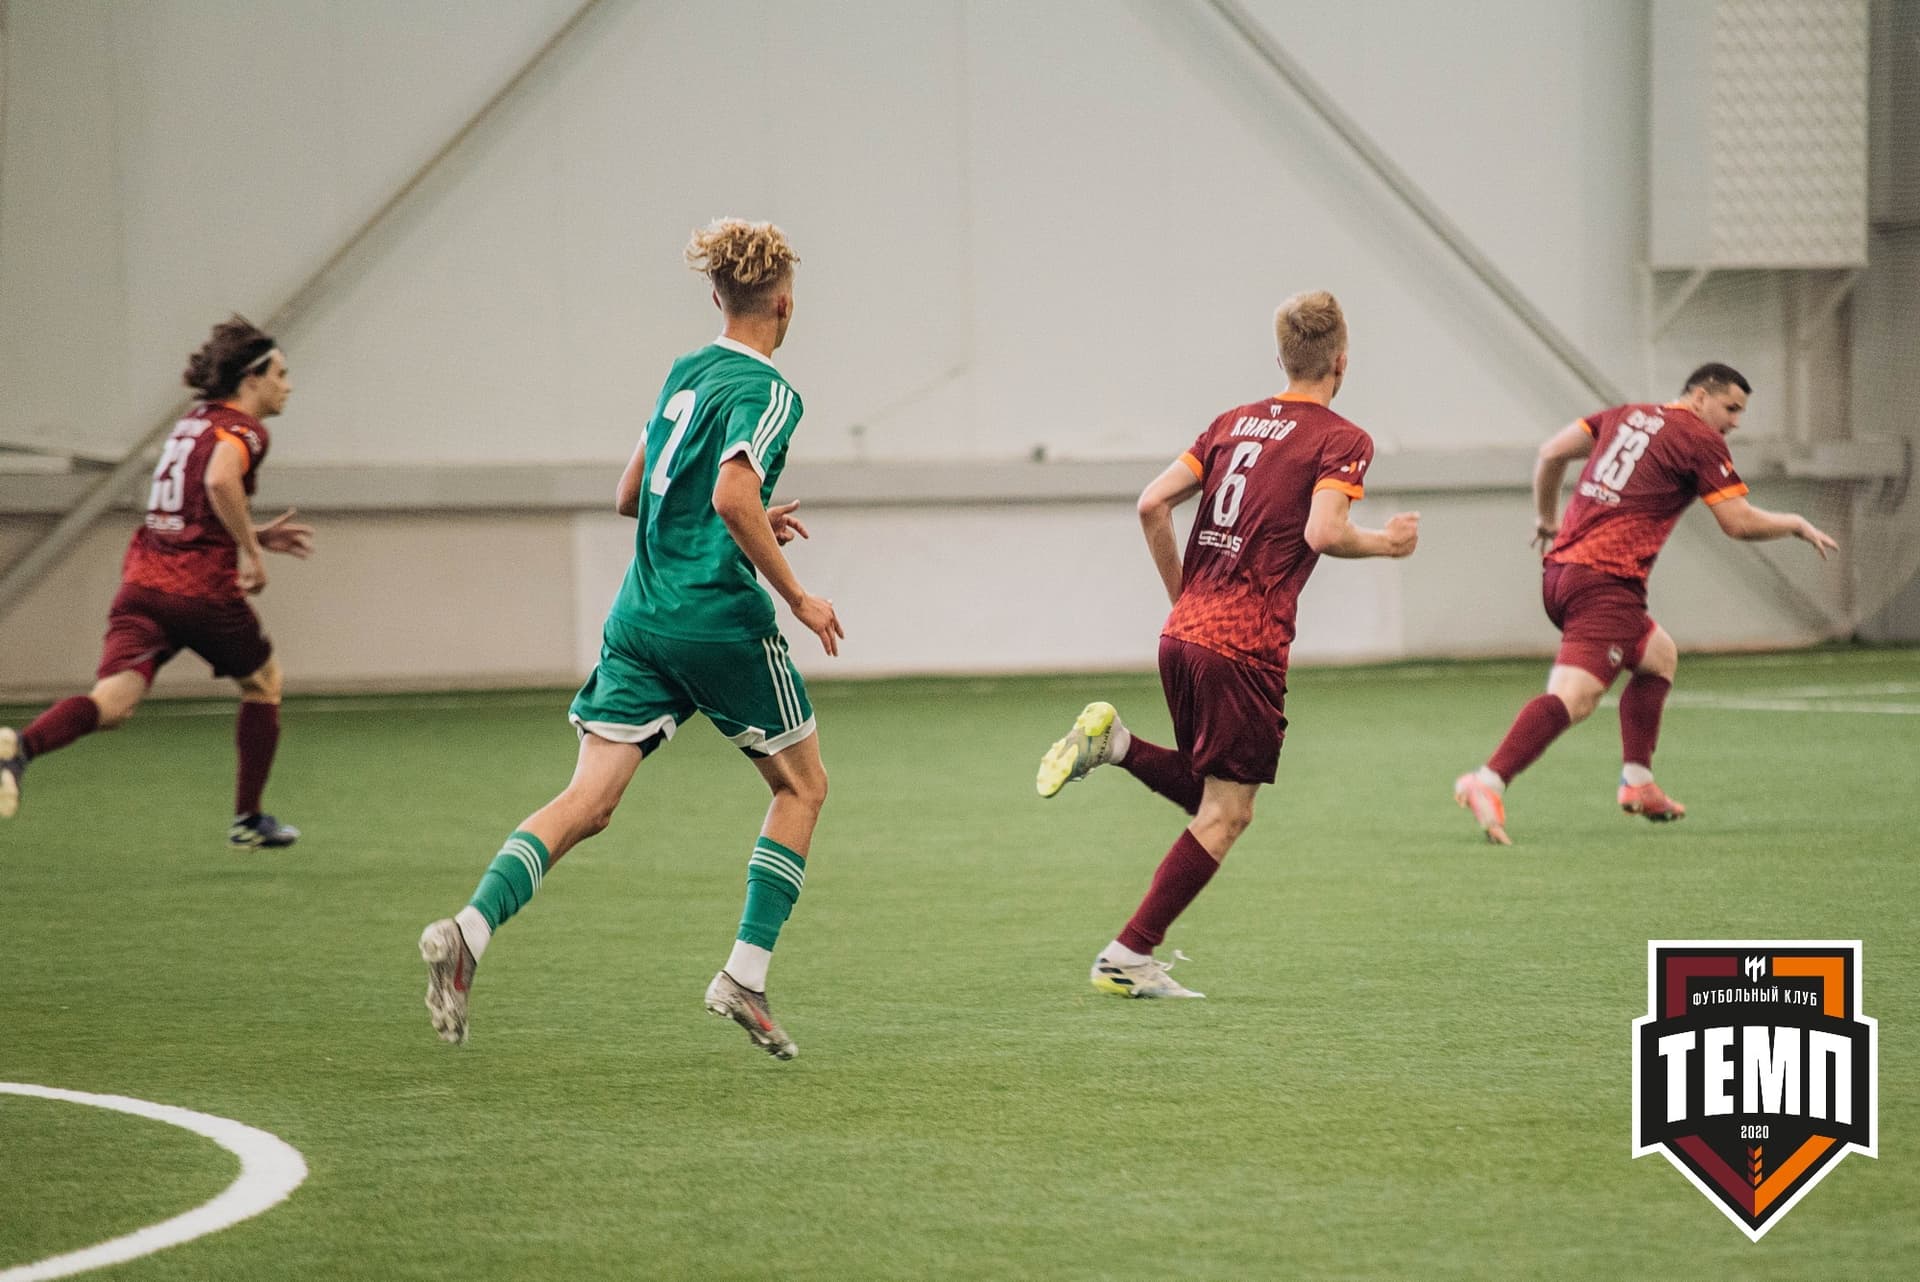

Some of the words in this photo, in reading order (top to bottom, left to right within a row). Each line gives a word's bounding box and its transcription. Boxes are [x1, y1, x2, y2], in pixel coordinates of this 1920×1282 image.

[650, 389, 697, 496] 2
[1213, 441, 1263, 527] 6
[1593, 422, 1650, 491] 13
